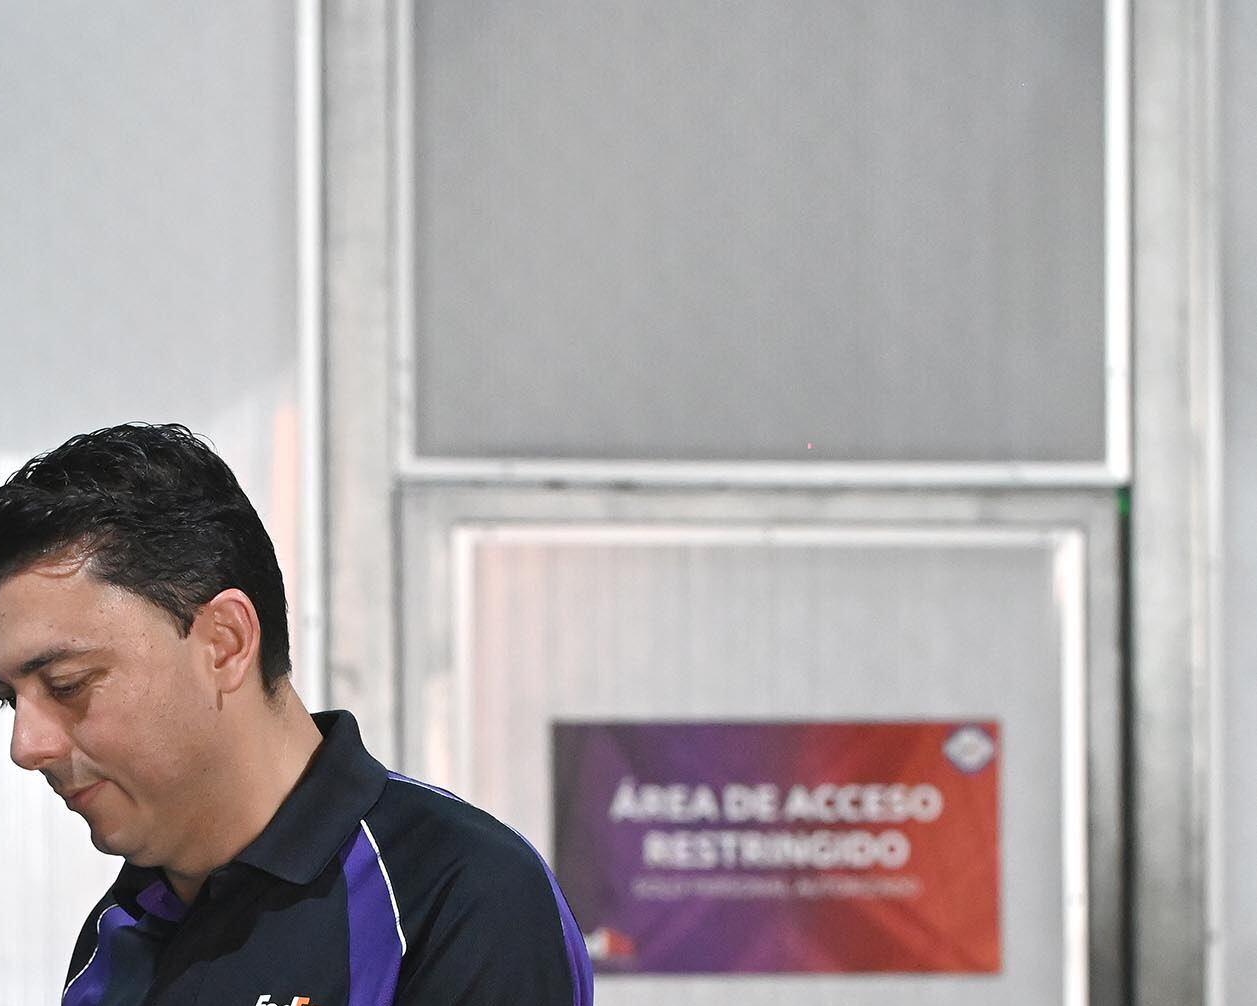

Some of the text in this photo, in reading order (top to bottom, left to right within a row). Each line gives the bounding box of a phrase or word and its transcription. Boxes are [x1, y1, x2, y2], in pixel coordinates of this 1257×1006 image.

[610, 777, 943, 822] ÁREA DE ACCESO
[643, 832, 911, 867] RESTRINGIDO
